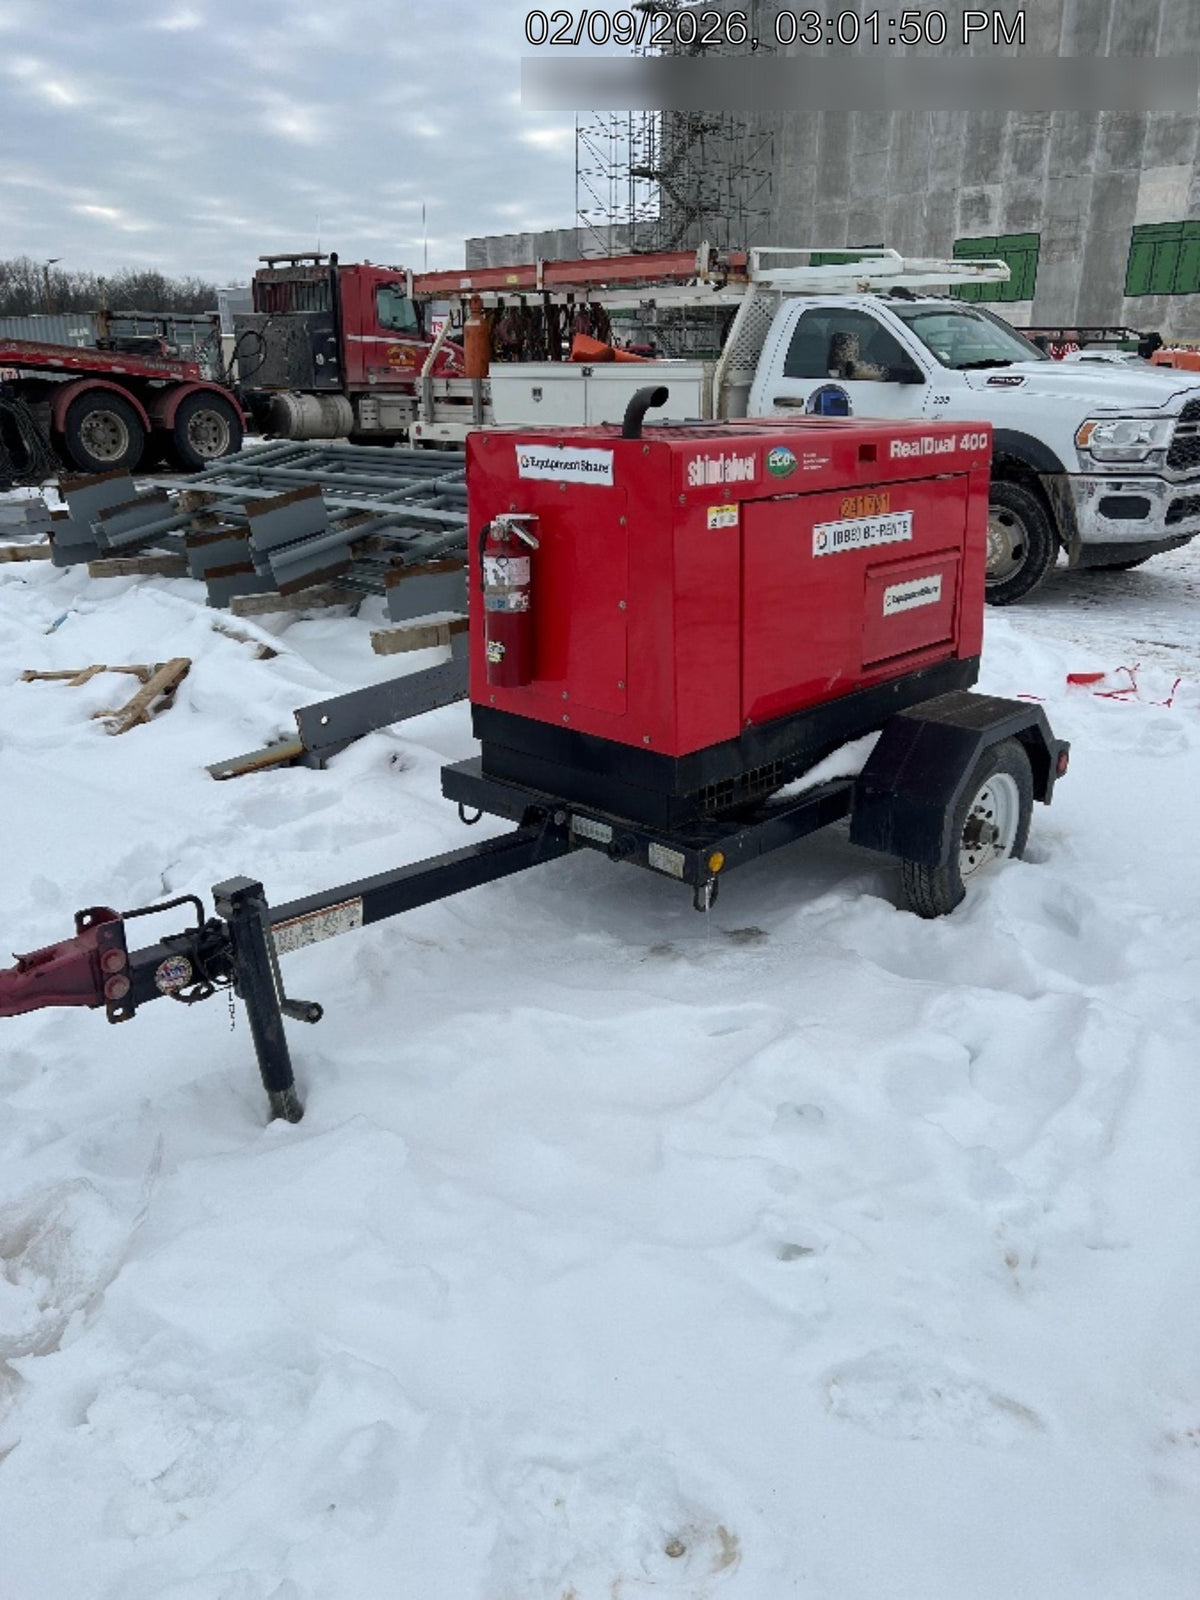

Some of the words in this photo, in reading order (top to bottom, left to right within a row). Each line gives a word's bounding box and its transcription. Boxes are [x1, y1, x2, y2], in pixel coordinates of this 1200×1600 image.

[890, 435, 956, 458] RealDual
[959, 432, 988, 451] 400
[688, 452, 756, 486] shindaiwa
